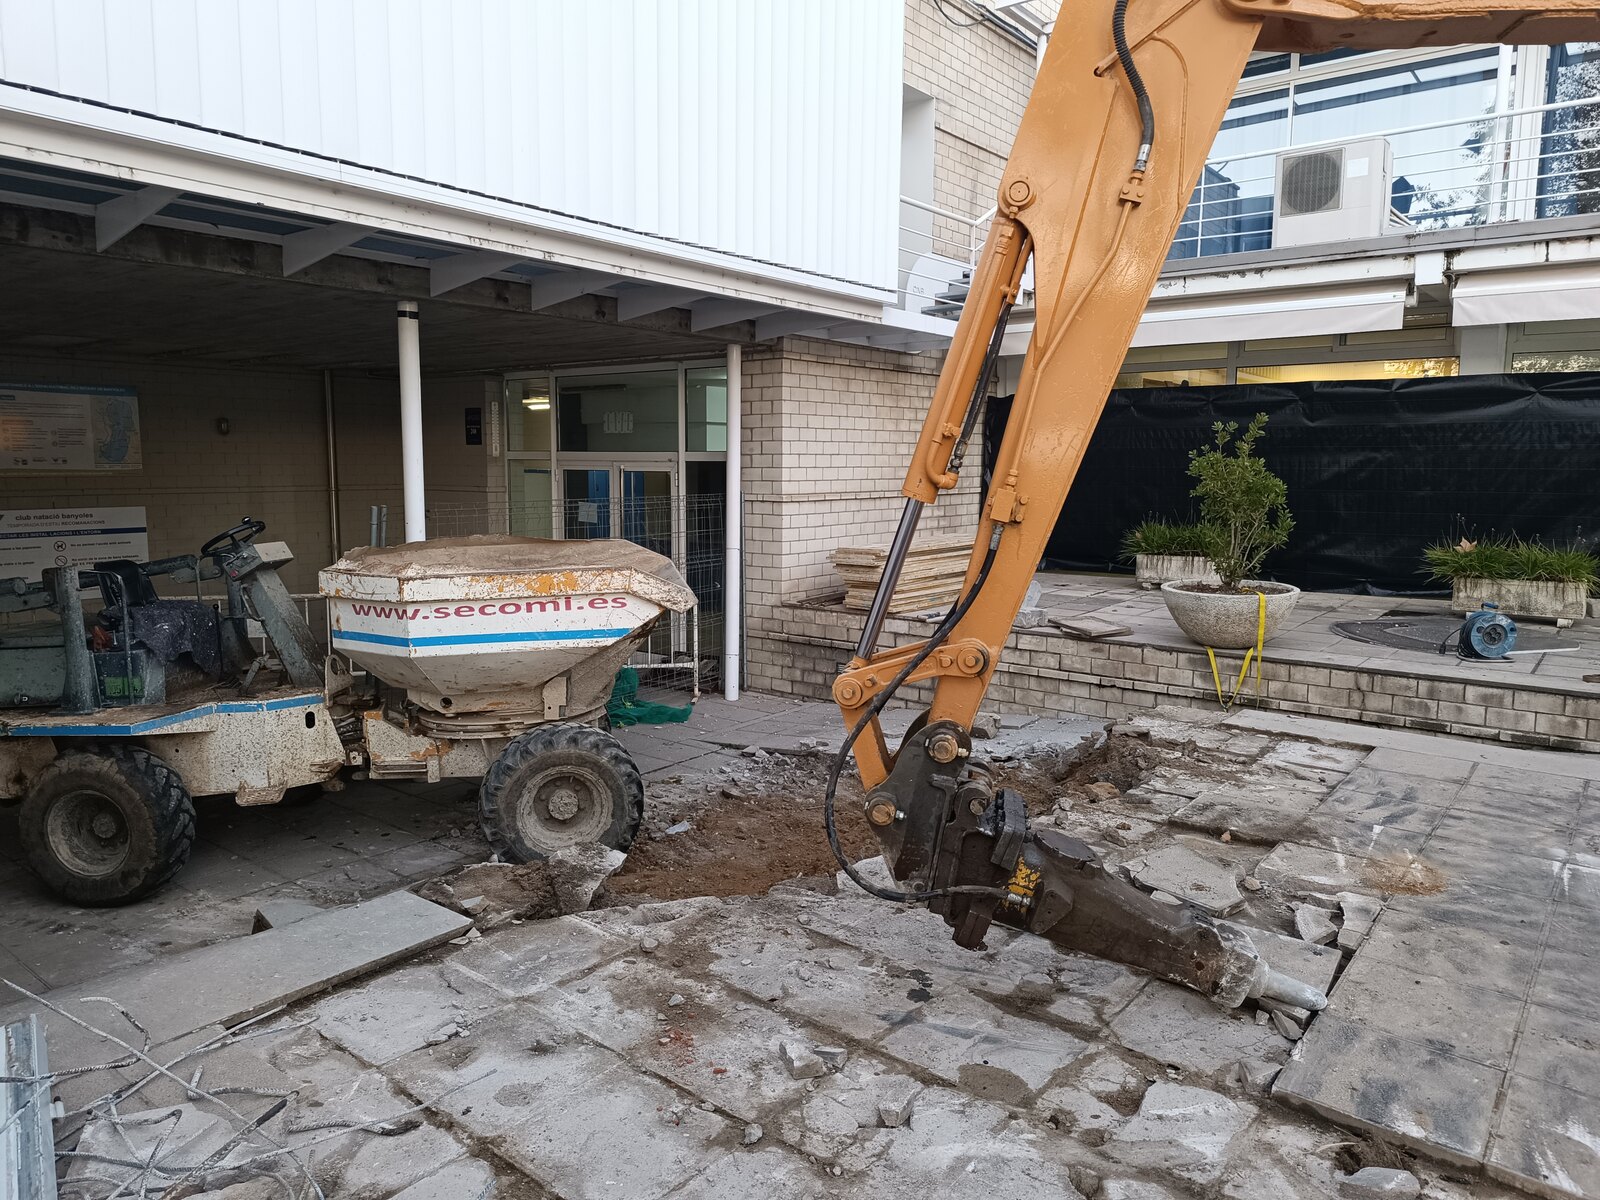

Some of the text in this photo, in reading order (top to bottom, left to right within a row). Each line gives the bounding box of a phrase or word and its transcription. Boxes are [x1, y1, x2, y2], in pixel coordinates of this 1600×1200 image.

[33, 512, 60, 520] natació
[61, 512, 94, 520] banyoles
[351, 596, 628, 621] www.secomi.es
